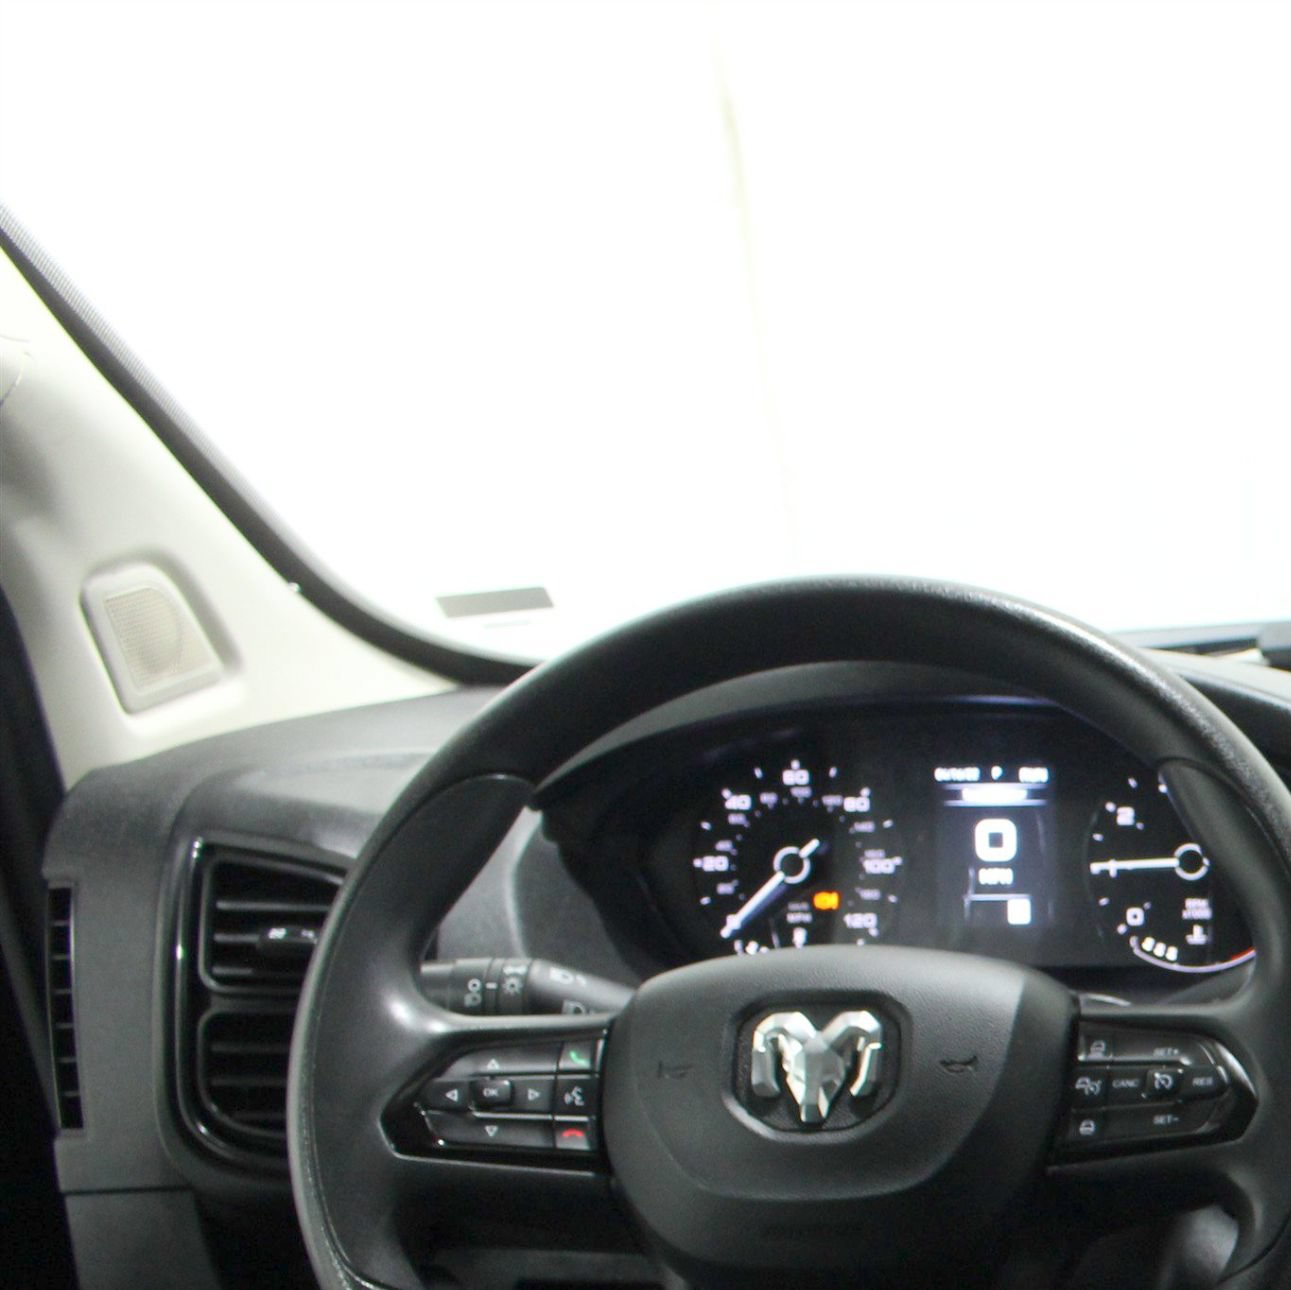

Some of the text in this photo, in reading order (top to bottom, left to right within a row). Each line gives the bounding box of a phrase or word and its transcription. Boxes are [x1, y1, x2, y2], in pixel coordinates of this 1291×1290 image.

[782, 769, 810, 786] 60
[725, 795, 752, 811] 40
[843, 797, 871, 812] 80
[1116, 806, 1135, 826] 2
[975, 818, 1017, 862] 0
[702, 855, 729, 872] 20
[863, 858, 895, 874] 100
[844, 912, 878, 928] 120
[1126, 907, 1144, 926] 0
[1112, 1079, 1140, 1089] CANC
[1193, 1078, 1214, 1087] RES
[483, 1088, 499, 1098] OK
